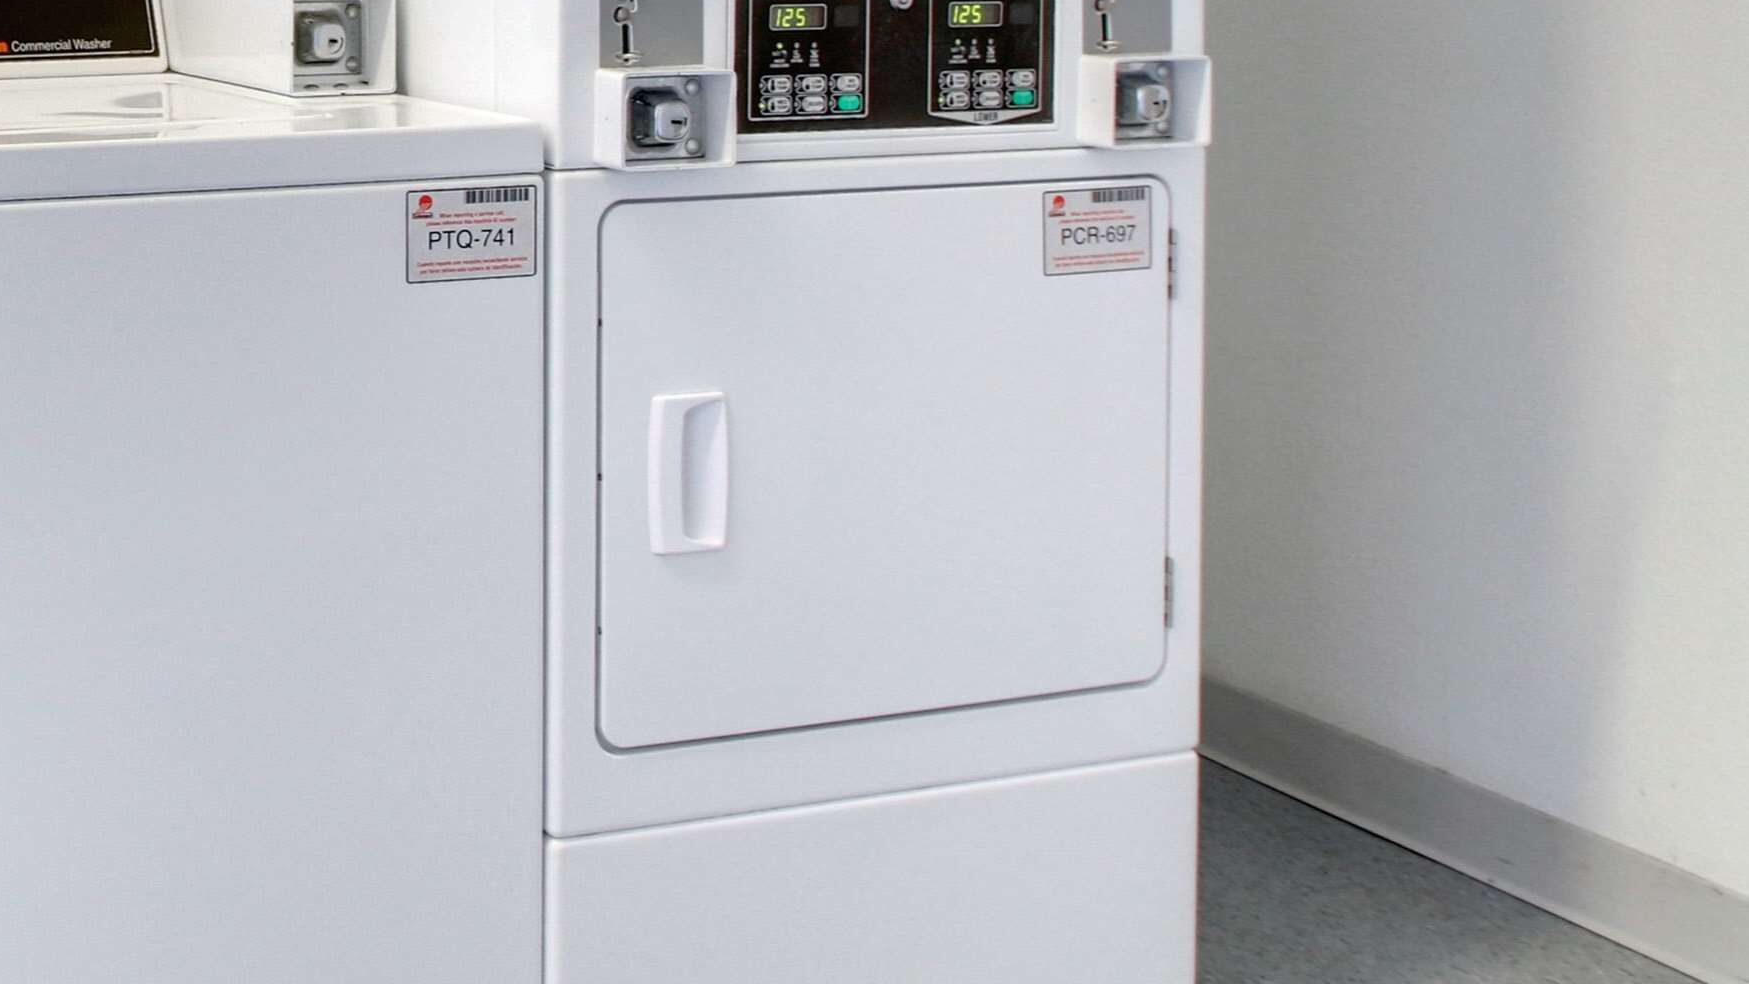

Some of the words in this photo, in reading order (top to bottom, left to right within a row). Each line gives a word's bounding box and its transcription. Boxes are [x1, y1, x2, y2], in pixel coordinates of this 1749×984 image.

[776, 8, 805, 27] 125
[953, 5, 982, 24] 125
[11, 39, 71, 52] Commercial
[73, 38, 112, 49] Washer
[429, 228, 514, 250] PTQ-741
[1061, 225, 1137, 246] PCR-697
